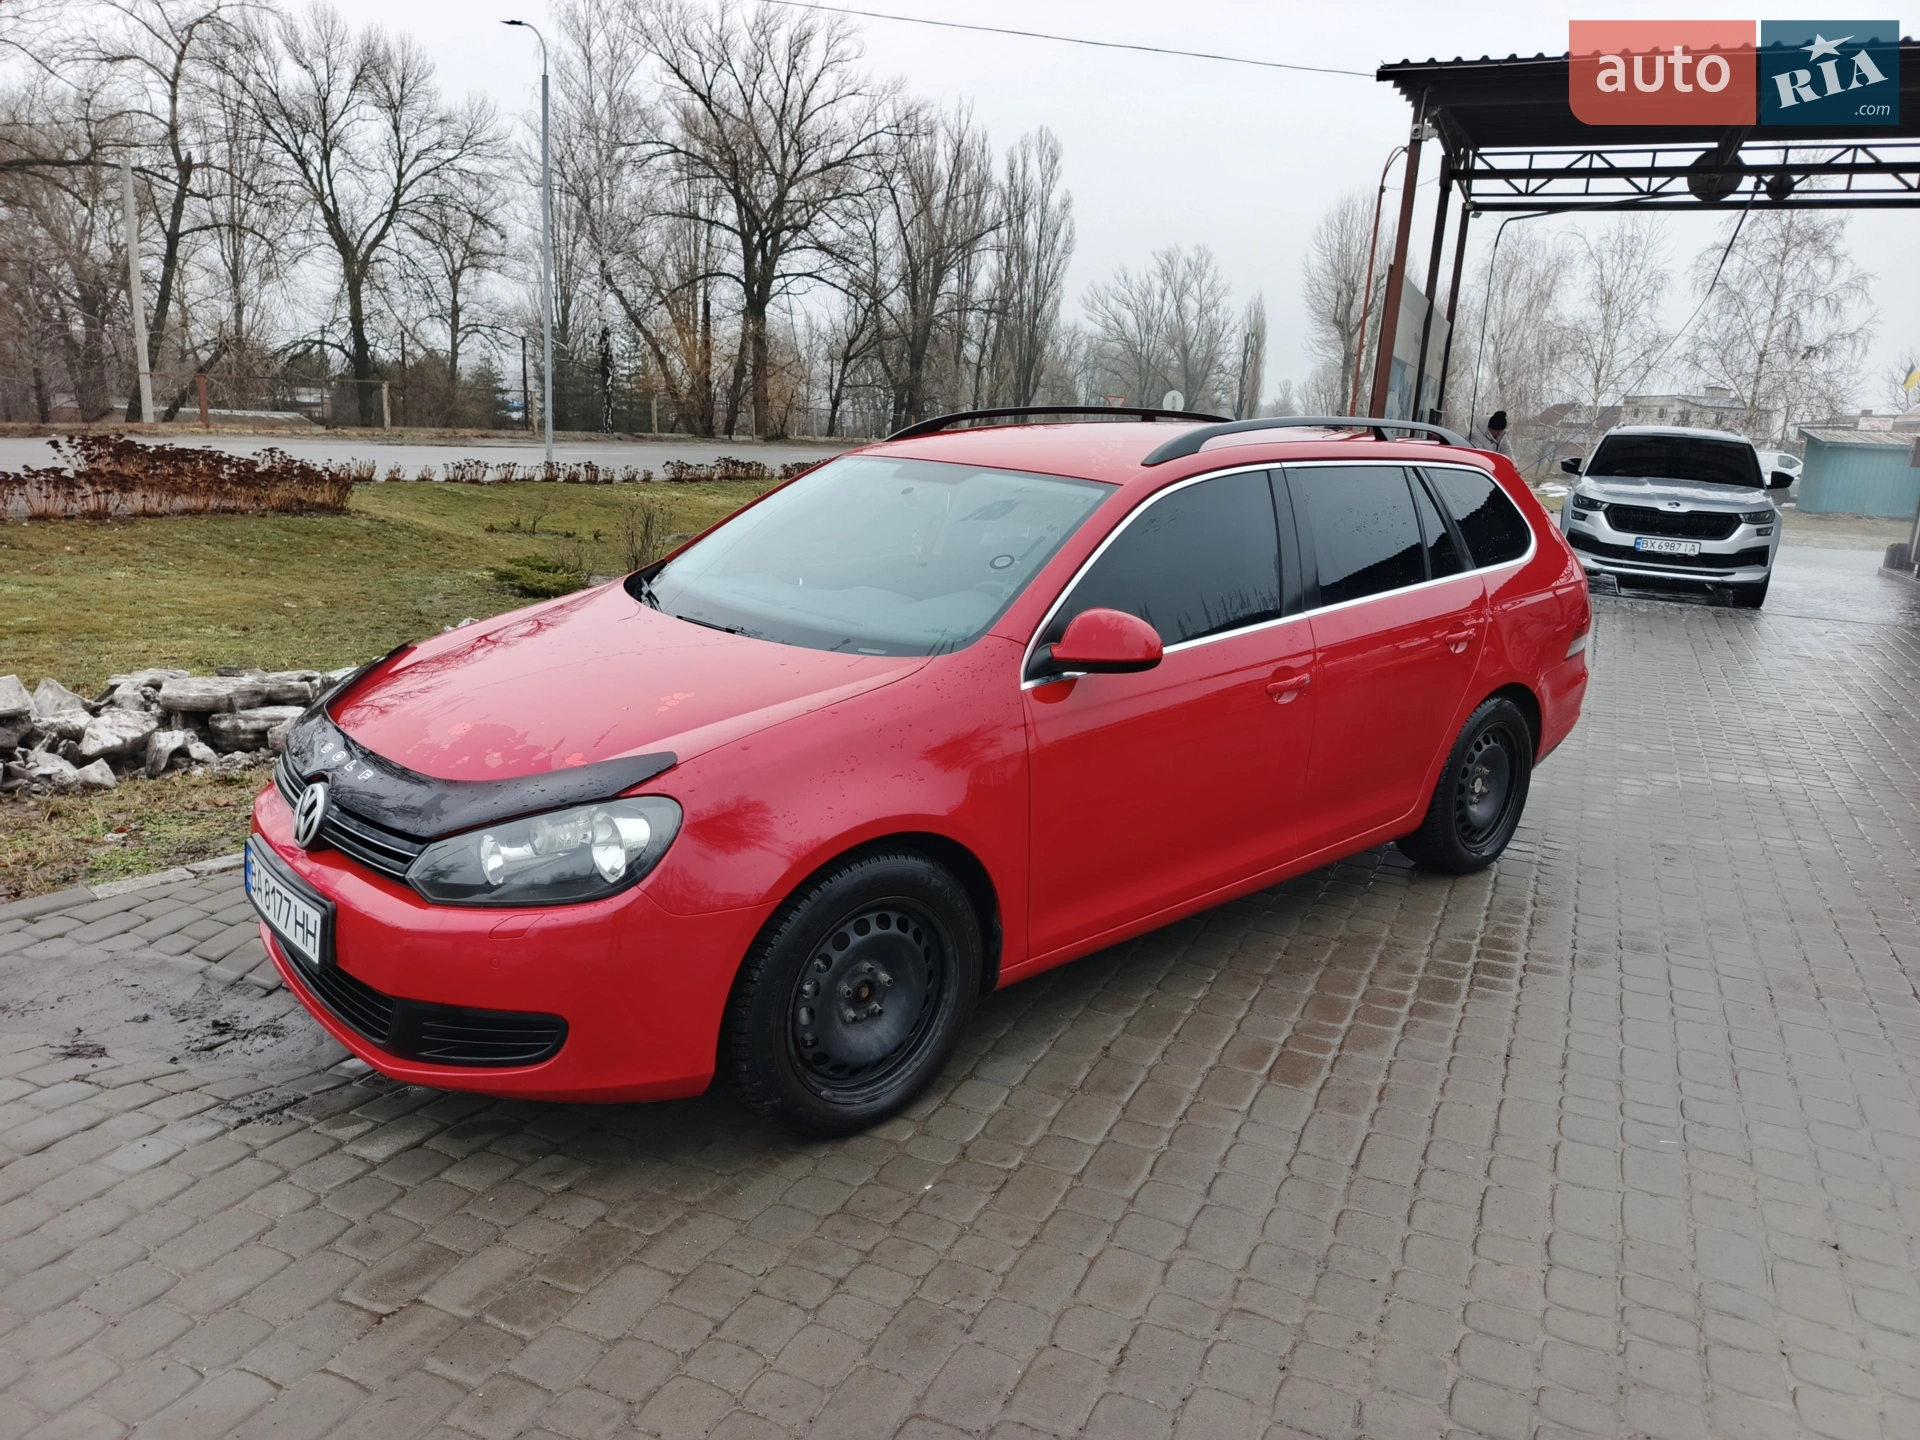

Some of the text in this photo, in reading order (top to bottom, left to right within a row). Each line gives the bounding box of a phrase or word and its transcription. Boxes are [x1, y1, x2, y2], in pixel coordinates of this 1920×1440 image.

[321, 742, 374, 780] GOLF
[264, 877, 292, 930] 8177
[294, 903, 318, 955] HH
